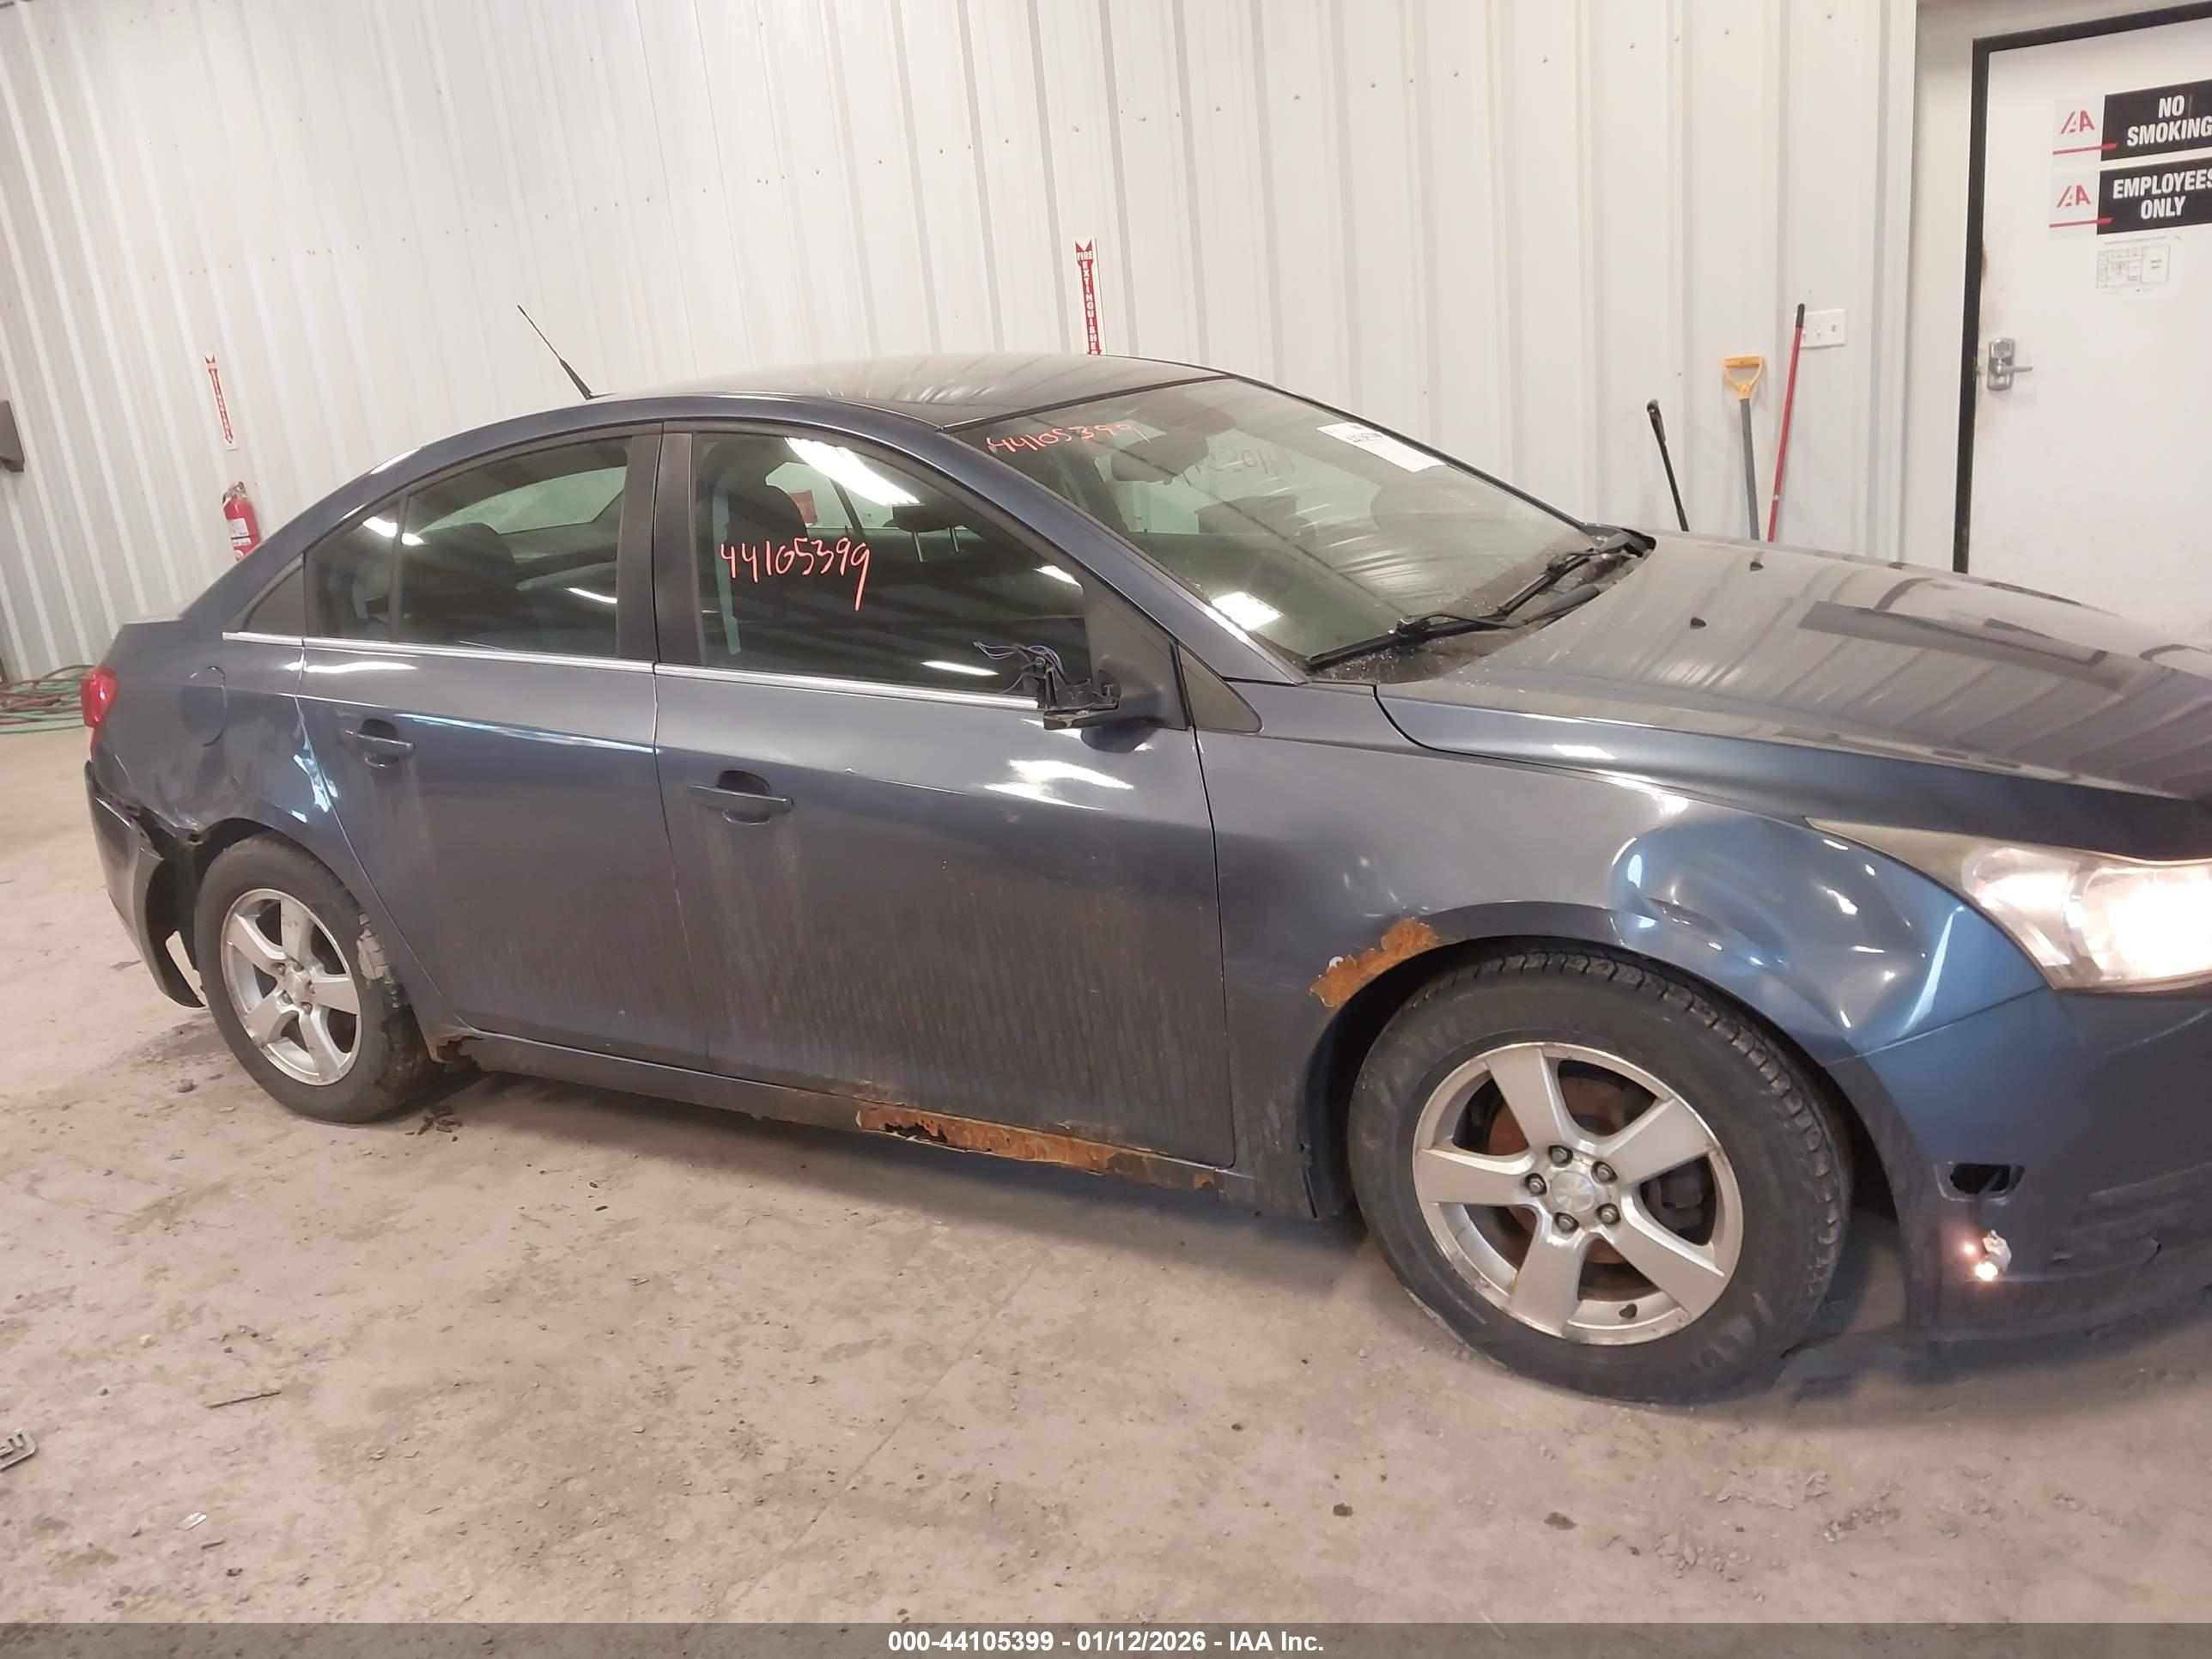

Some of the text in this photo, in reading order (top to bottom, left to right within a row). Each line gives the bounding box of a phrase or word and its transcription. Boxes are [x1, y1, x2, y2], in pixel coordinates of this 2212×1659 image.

[2158, 94, 2185, 118] NO
[2126, 115, 2212, 147] SMOKING
[2140, 195, 2186, 220] ONLY
[720, 536, 871, 612] 44105399
